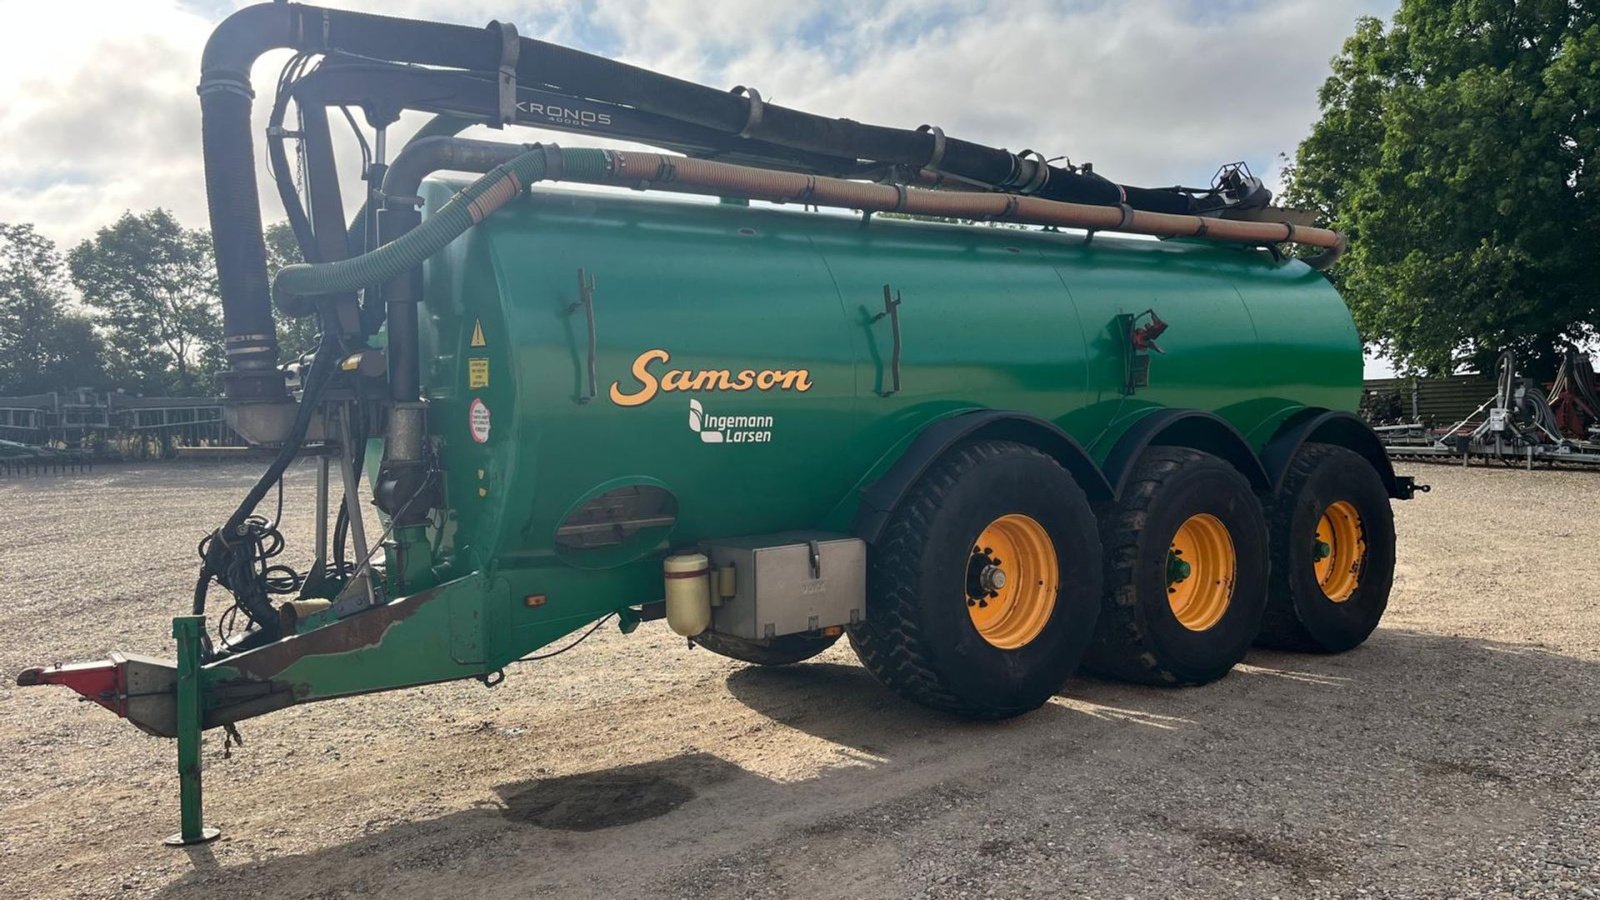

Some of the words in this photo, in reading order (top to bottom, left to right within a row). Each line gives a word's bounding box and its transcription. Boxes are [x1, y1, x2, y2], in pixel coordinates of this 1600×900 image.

[516, 101, 612, 125] KRONOS
[609, 348, 813, 407] Samson
[704, 413, 773, 431] Ingemann
[726, 430, 771, 443] Larsen
